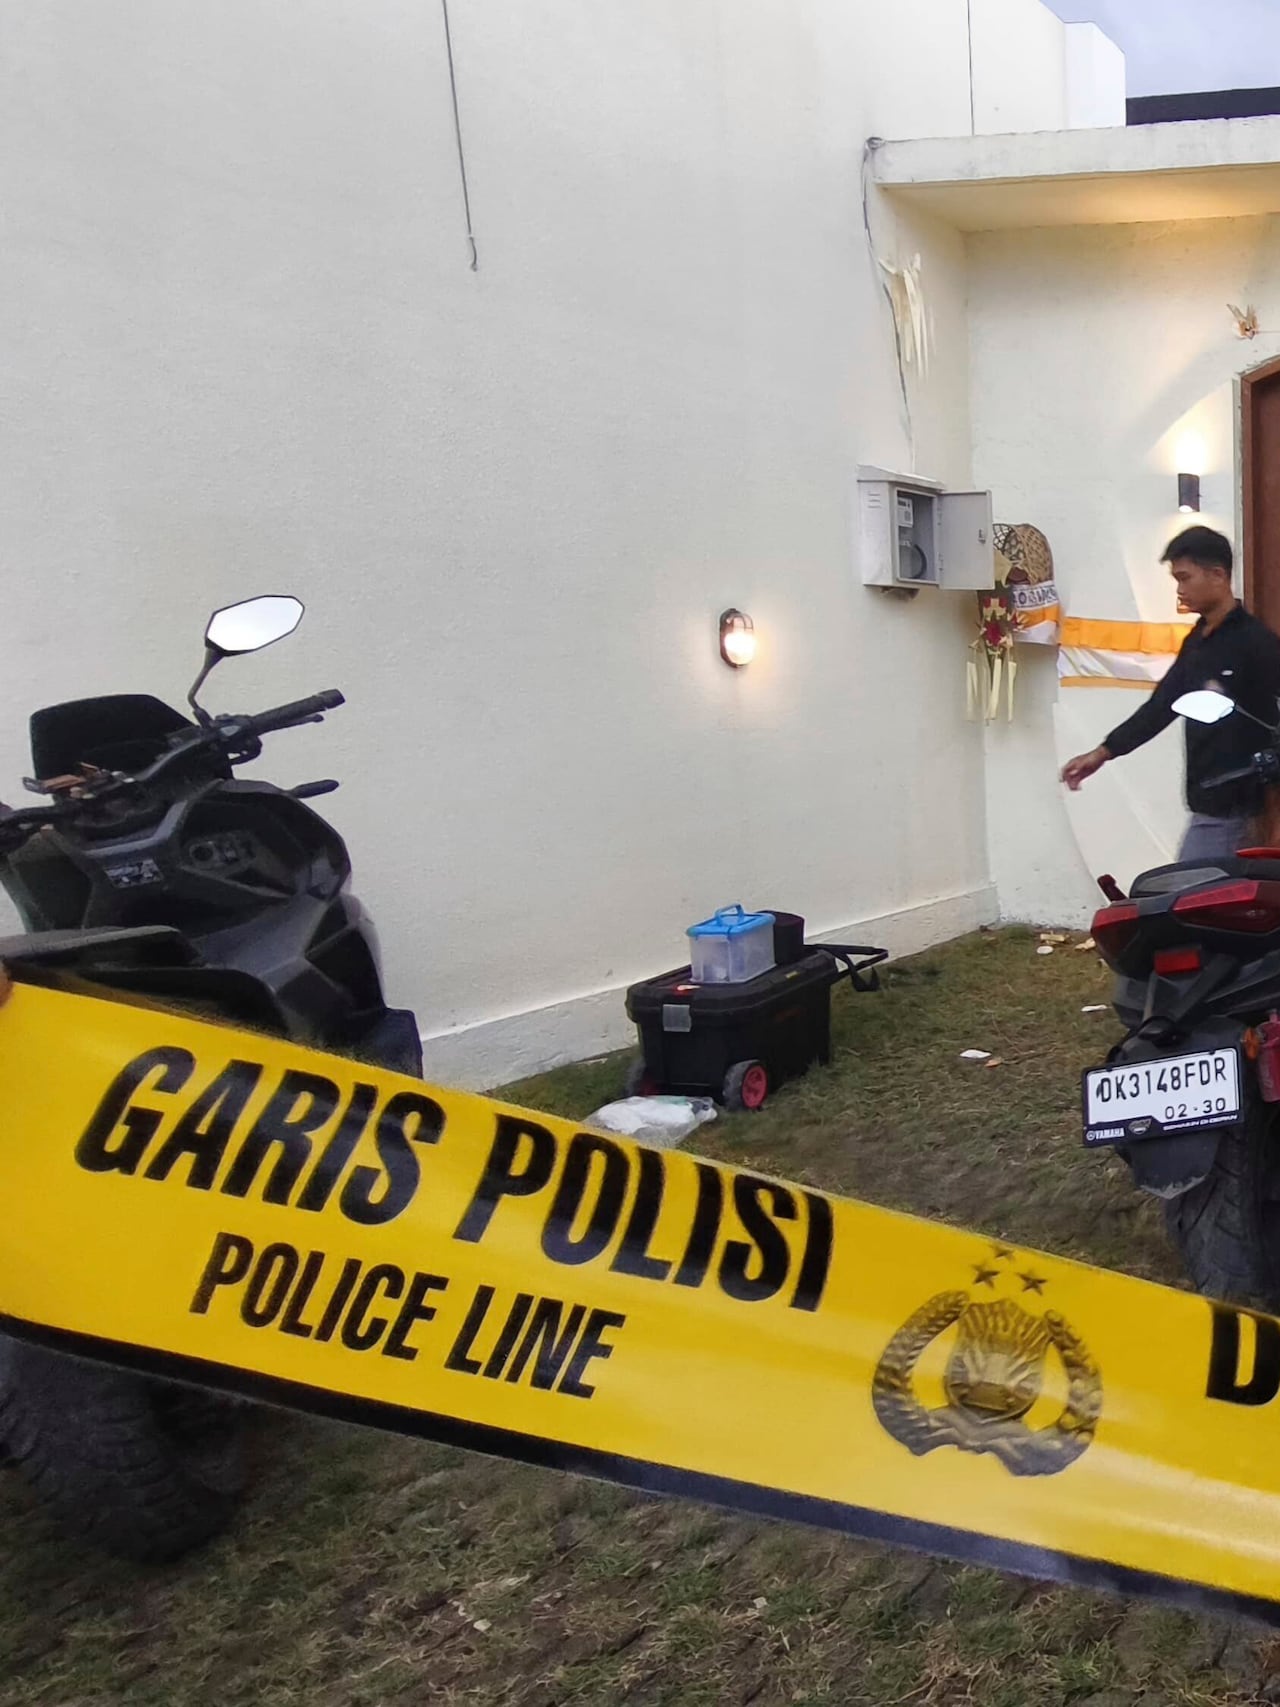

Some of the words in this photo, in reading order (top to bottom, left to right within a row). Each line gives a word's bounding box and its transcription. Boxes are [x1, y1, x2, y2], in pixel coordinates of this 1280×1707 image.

[1096, 1056, 1228, 1103] DK3148FDR
[73, 1046, 447, 1226] GARIS
[453, 1112, 835, 1312] POLISI
[1095, 1127, 1125, 1140] YAMAHA
[190, 1232, 448, 1361] POLICE
[444, 1284, 627, 1400] LINE
